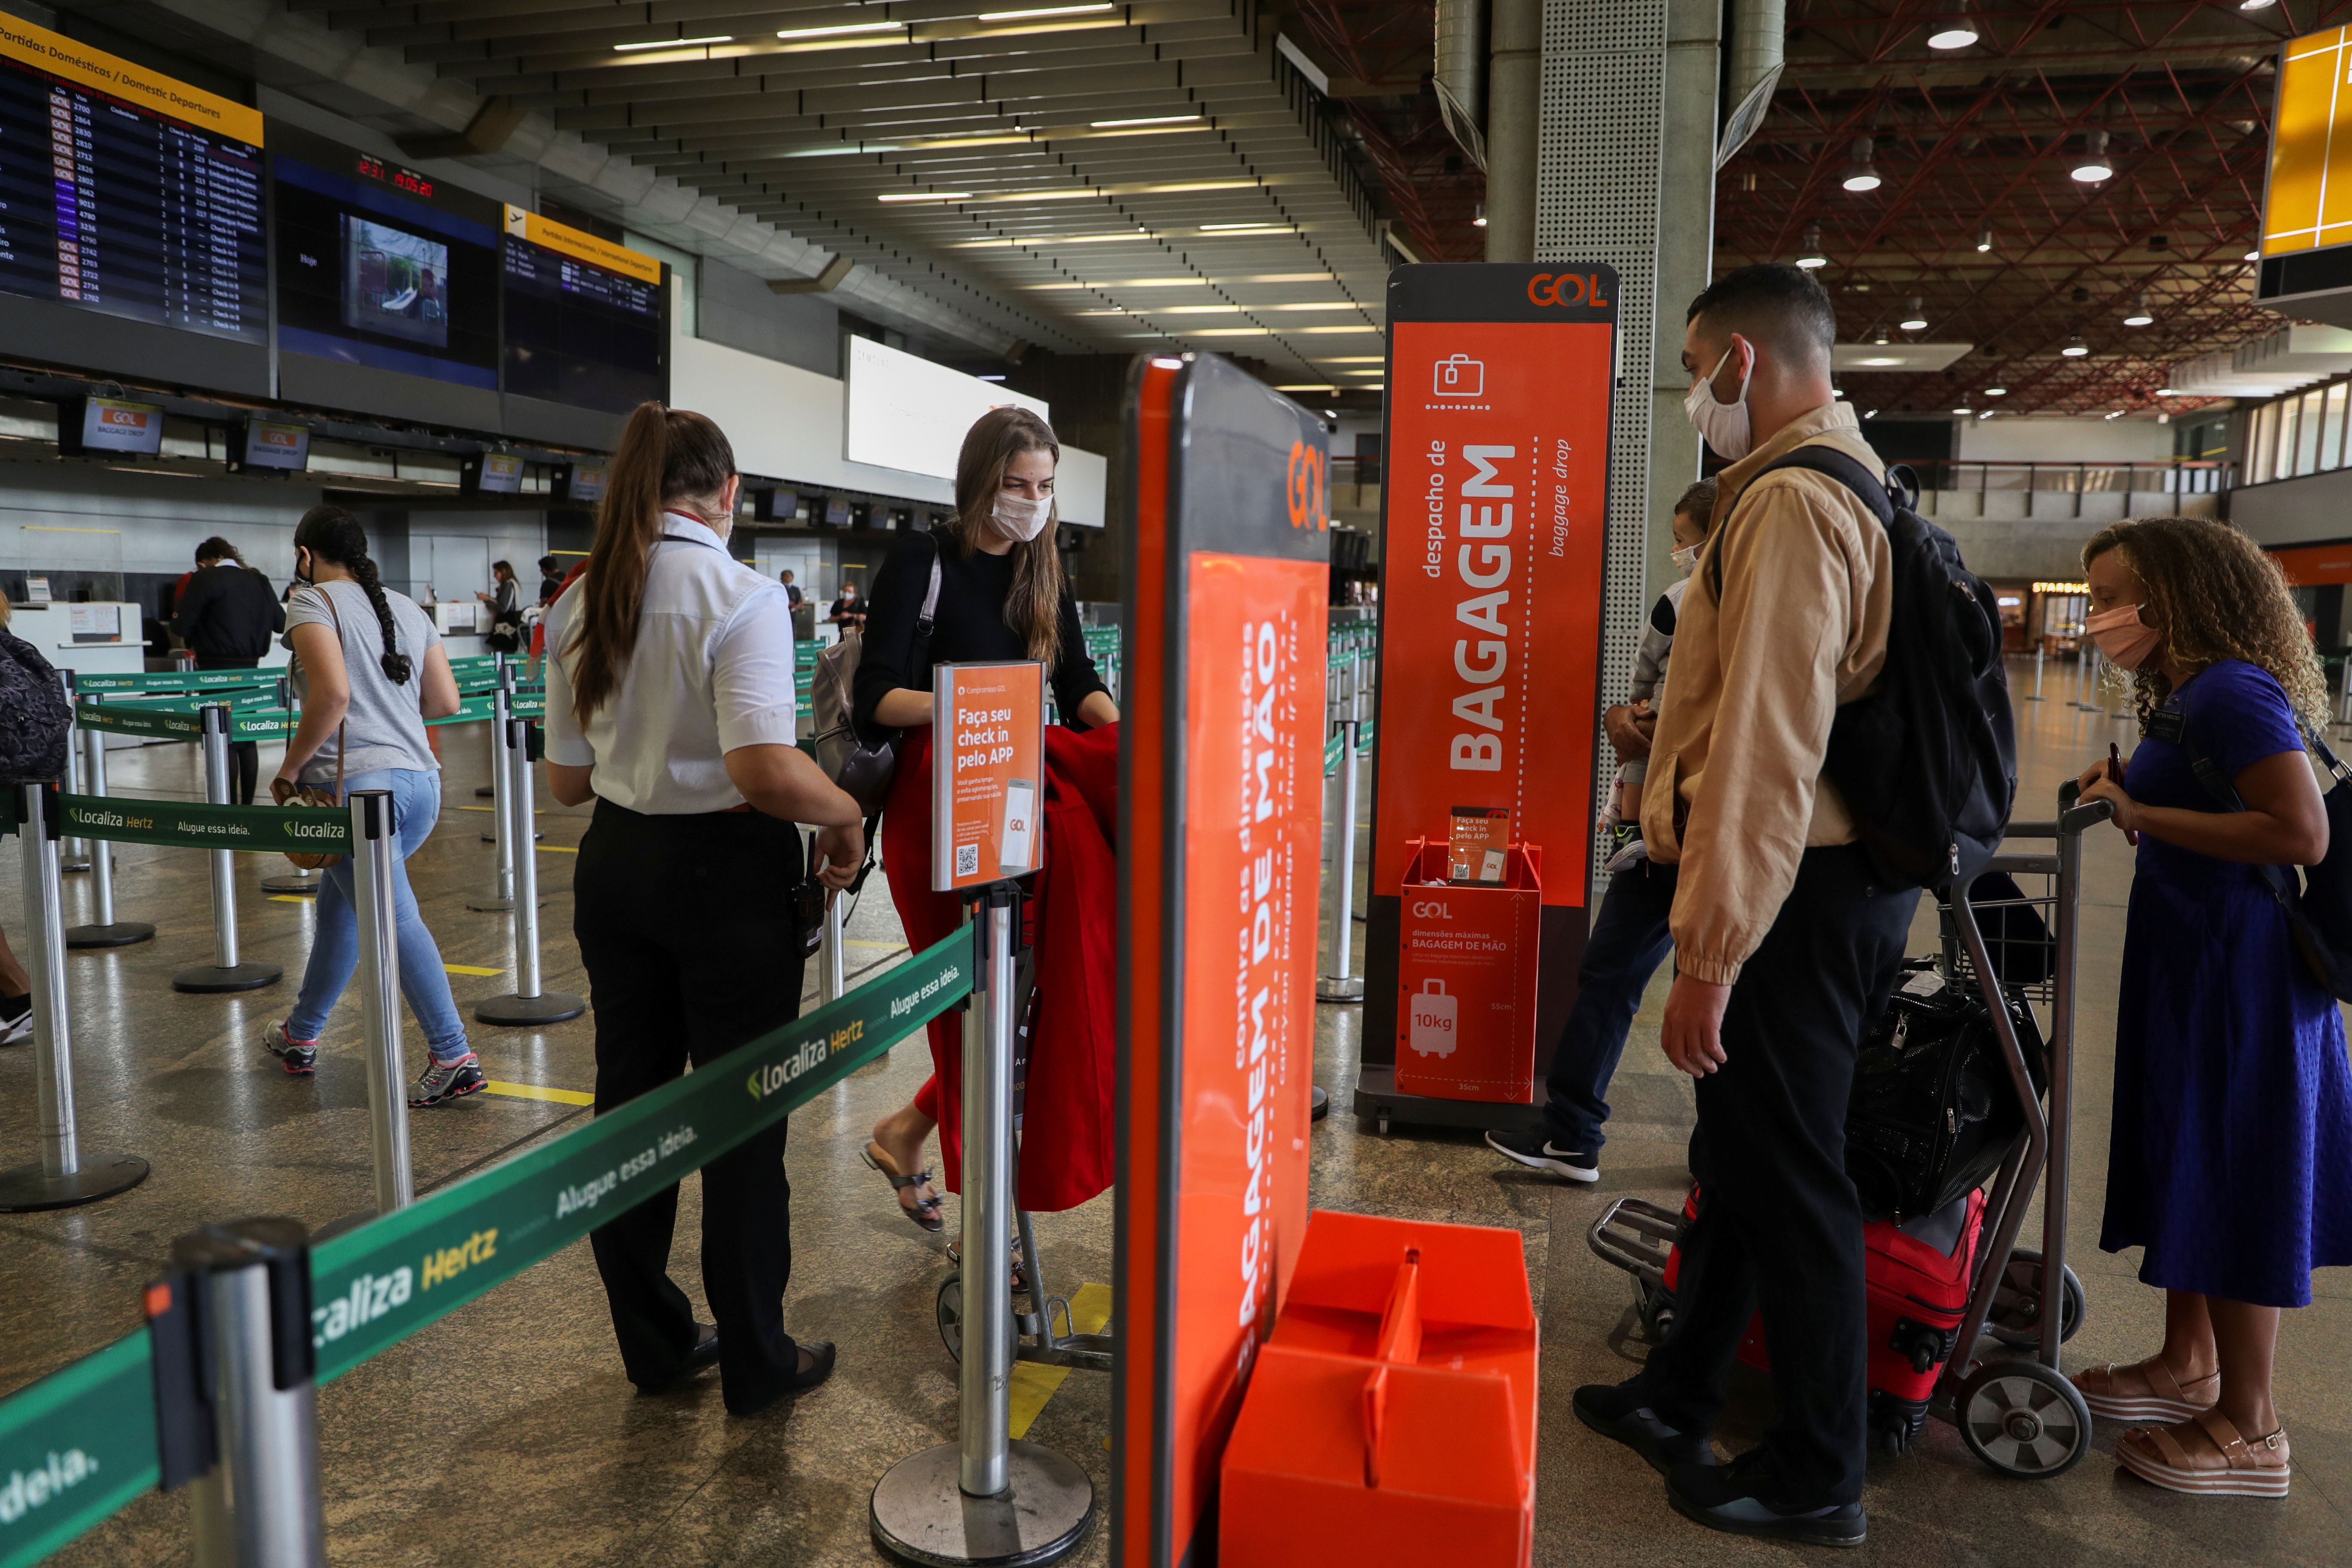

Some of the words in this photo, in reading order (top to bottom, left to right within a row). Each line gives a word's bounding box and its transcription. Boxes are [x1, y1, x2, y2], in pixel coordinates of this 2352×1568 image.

[0, 27, 46, 54] Partidas
[49, 46, 111, 78] Domésticas
[113, 71, 120, 82] /
[122, 74, 168, 99] Domestic
[170, 92, 221, 119] Departures
[51, 95, 70, 109] GOL
[74, 103, 91, 114] 2700
[75, 93, 87, 103] Voo
[52, 108, 71, 121] GOL
[74, 115, 91, 126] 2864
[52, 120, 72, 133] GOL
[75, 127, 92, 138] 2830
[53, 132, 72, 145] GOL
[76, 139, 92, 150] 2810
[54, 144, 73, 156] GOL
[77, 151, 93, 162] 2712
[54, 156, 74, 169] GOL
[55, 169, 74, 181] GOL
[79, 199, 95, 209] 9013
[59, 241, 78, 253] GOL
[59, 253, 79, 265] GOL
[60, 265, 79, 277] GOL
[61, 277, 80, 288] GOL
[1527, 273, 1608, 307] GOL
[61, 288, 80, 300] GOL
[113, 411, 136, 425] GOL
[1426, 439, 1446, 466] de
[1552, 438, 1572, 479] drop
[1287, 440, 1327, 531] GOL
[1422, 473, 1446, 578] despacho
[1548, 484, 1570, 557] baggage
[2032, 582, 2089, 594] STARBUC
[1450, 444, 1516, 772] BAGAGEM
[967, 686, 996, 695] Compromisso
[517, 700, 538, 709] Localiza
[83, 711, 101, 722] Localiza
[169, 720, 190, 731] Localiza
[247, 720, 279, 731] Localiza
[281, 721, 299, 729] Hertz
[959, 708, 988, 728] Faça
[991, 709, 1011, 722] seu
[1252, 621, 1276, 824] MÃO
[958, 727, 995, 747] check
[998, 726, 1008, 742] in
[1239, 622, 1253, 853] dimensões
[958, 750, 986, 772] pelo
[989, 746, 1014, 765] APP
[1286, 733, 1295, 811] check
[968, 778, 981, 786] ganha
[957, 794, 982, 803] preservando
[79, 808, 123, 827] Localiza
[126, 816, 153, 830] Hertz
[178, 821, 205, 836] Alugue
[207, 823, 227, 834] essa
[228, 821, 251, 836] ideia.
[295, 821, 344, 839] Localiza
[1010, 818, 1026, 832] GOL
[1457, 817, 1473, 825] Faça
[1239, 864, 1251, 914] as
[1253, 847, 1272, 965] DE
[1283, 842, 1293, 960] baggage
[1412, 901, 1453, 919] GOL
[1412, 929, 1453, 938] dimensões
[1455, 931, 1490, 940] máximas
[1412, 939, 1463, 949] BAGAGEM
[1466, 941, 1479, 950] DE
[1482, 940, 1507, 951] MÃO
[1235, 926, 1249, 1069] confira
[1415, 1014, 1452, 1032] 10kg
[1458, 1084, 1479, 1092] 35cm
[311, 1265, 413, 1349] caliza
[421, 1227, 499, 1291] Hertz
[555, 1168, 617, 1219] Alugue
[619, 1151, 656, 1184] essa
[658, 1124, 698, 1158] ideia.
[762, 1038, 827, 1097] Localiza
[830, 1019, 864, 1055] Hertz
[890, 990, 920, 1019] Alugue
[921, 977, 939, 1000] essa
[940, 965, 960, 989] ideia.
[0, 1447, 99, 1525] deia.
